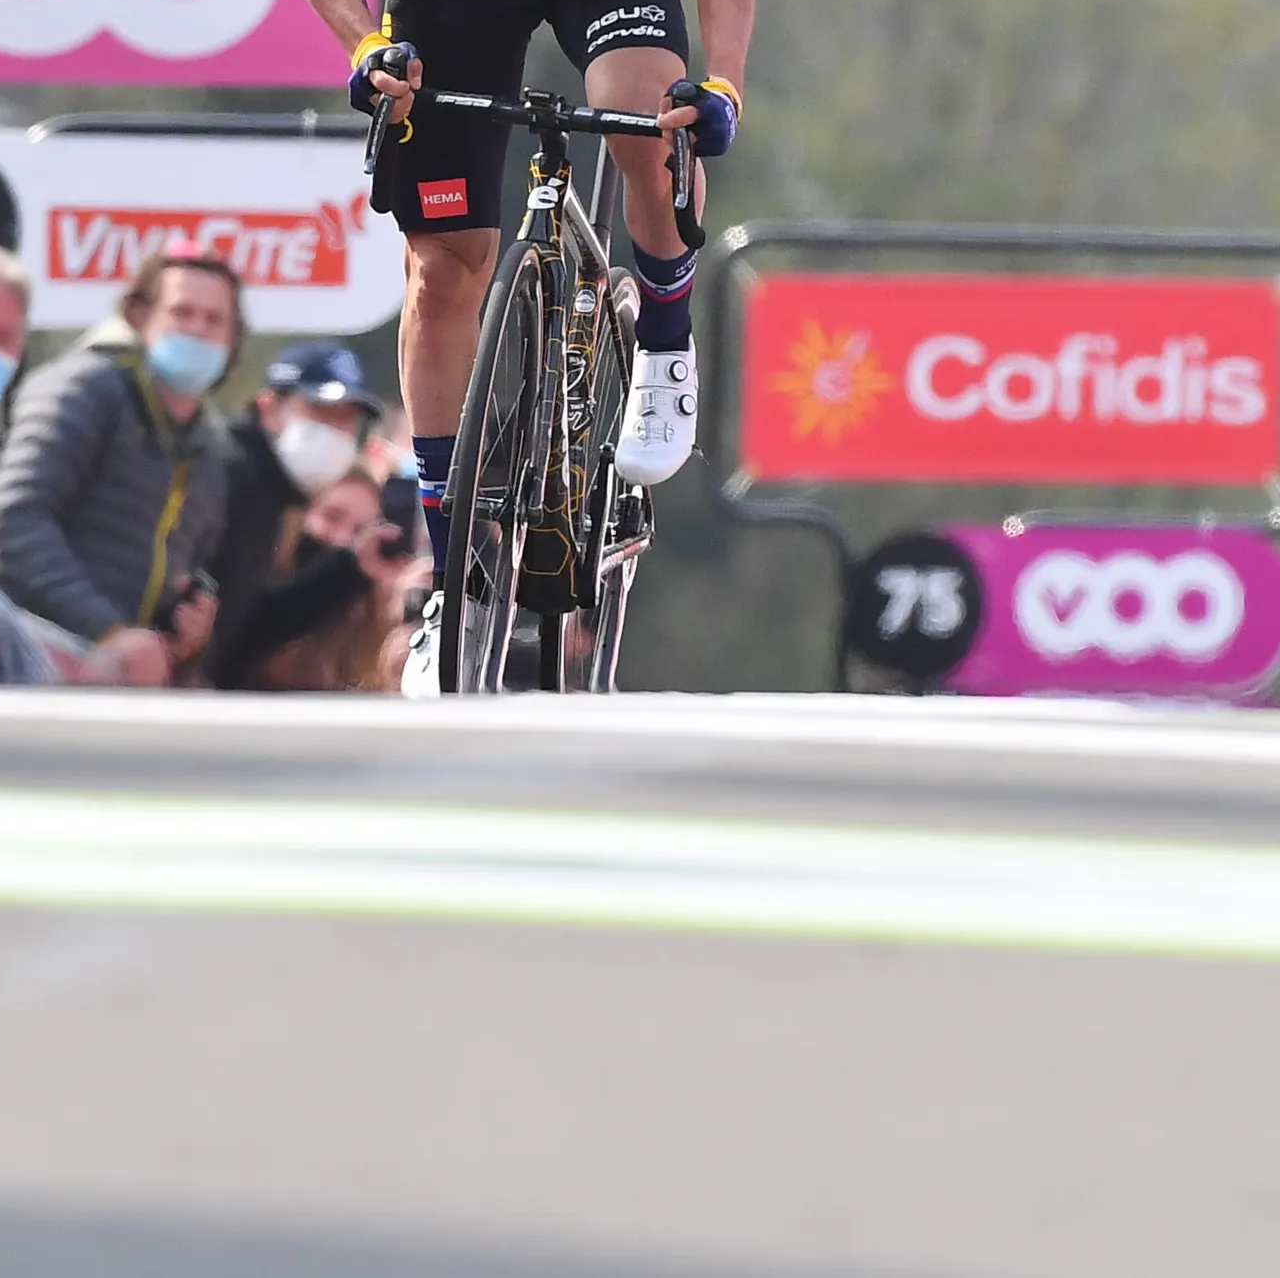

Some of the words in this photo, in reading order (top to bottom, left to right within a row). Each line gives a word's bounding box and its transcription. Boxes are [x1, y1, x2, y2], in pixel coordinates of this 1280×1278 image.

[586, 6, 641, 41] AGU
[587, 25, 667, 54] cervélo
[423, 192, 464, 207] HEMA
[905, 332, 1269, 426] Cofidis
[876, 564, 968, 642] 75
